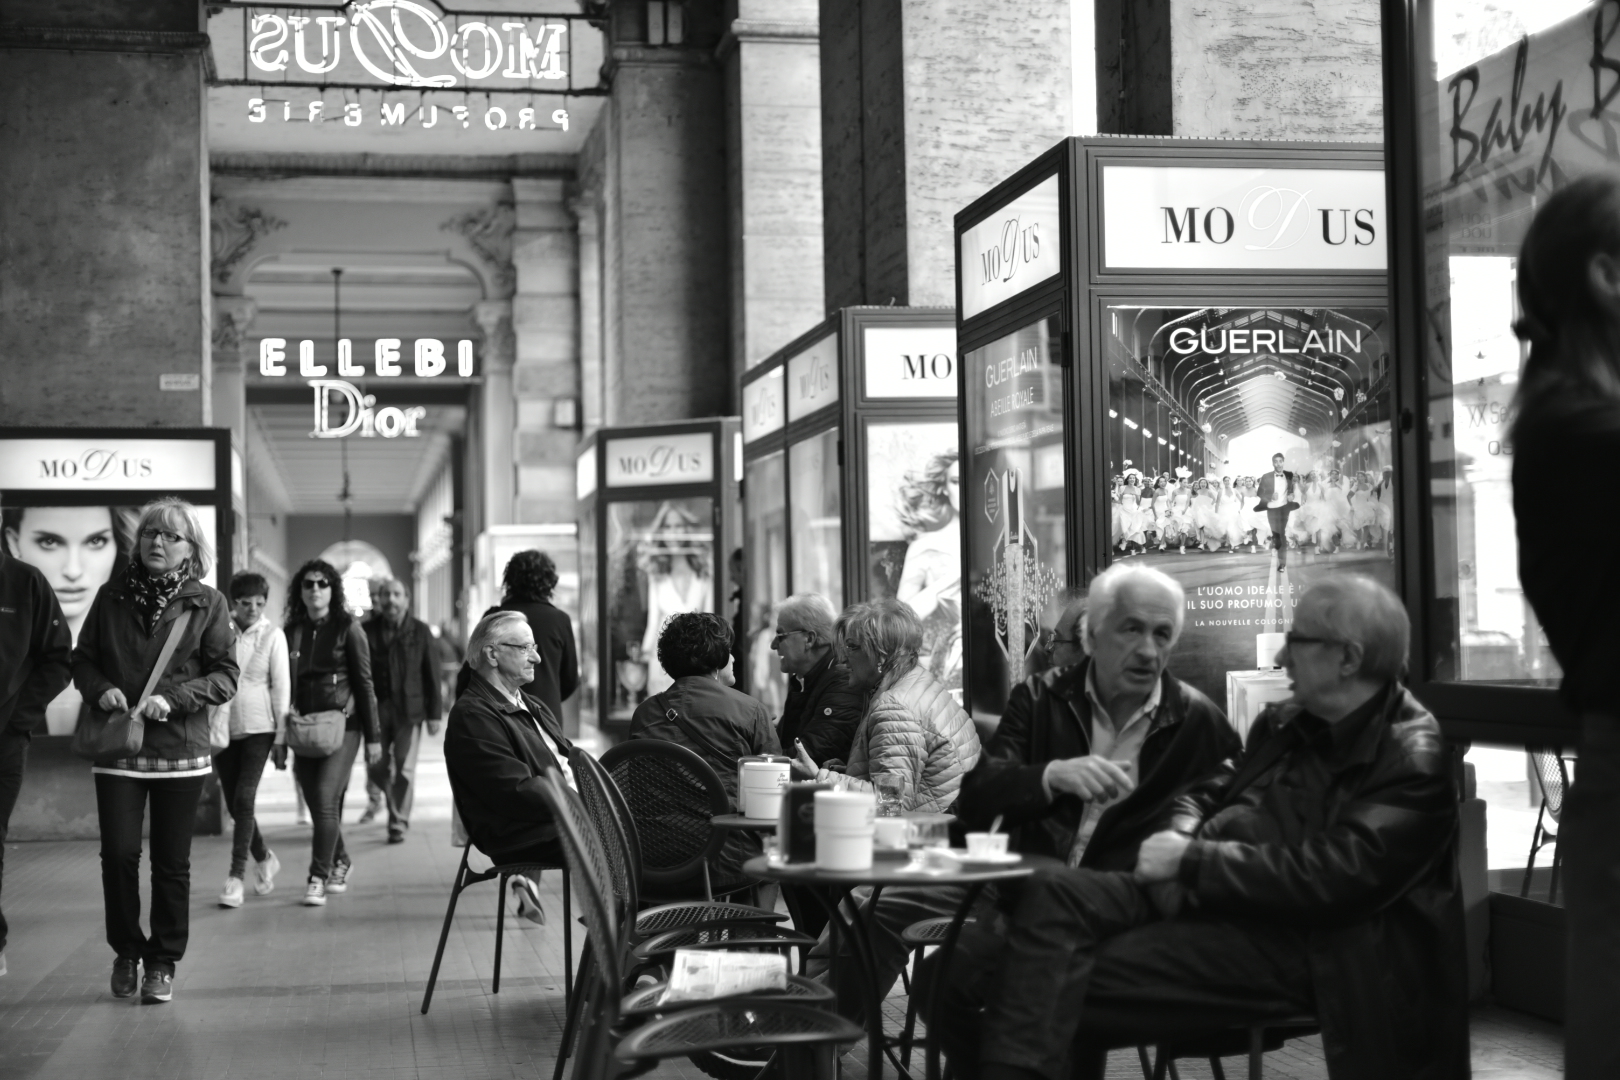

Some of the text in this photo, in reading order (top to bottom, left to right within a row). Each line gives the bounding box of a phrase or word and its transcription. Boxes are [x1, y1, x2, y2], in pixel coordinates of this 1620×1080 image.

[1160, 185, 1376, 251] MODUS
[981, 214, 1040, 286] MODUS
[1169, 327, 1361, 354] GUERLAIN
[260, 338, 473, 377] ELLEBI
[901, 353, 953, 380] MO
[985, 346, 1038, 388] GUERLAIN
[307, 379, 426, 438] Dior
[1011, 386, 1034, 410] ROYALE
[38, 448, 152, 480] MODUS
[618, 444, 702, 477] MODUS
[1187, 601, 1196, 610] IL
[1200, 600, 1223, 610] SUO
[1227, 599, 1286, 609] PROFUMO,
[1197, 586, 1243, 596] L'UOMO
[1247, 585, 1284, 595] IDEALE
[1288, 582, 1295, 594] È
